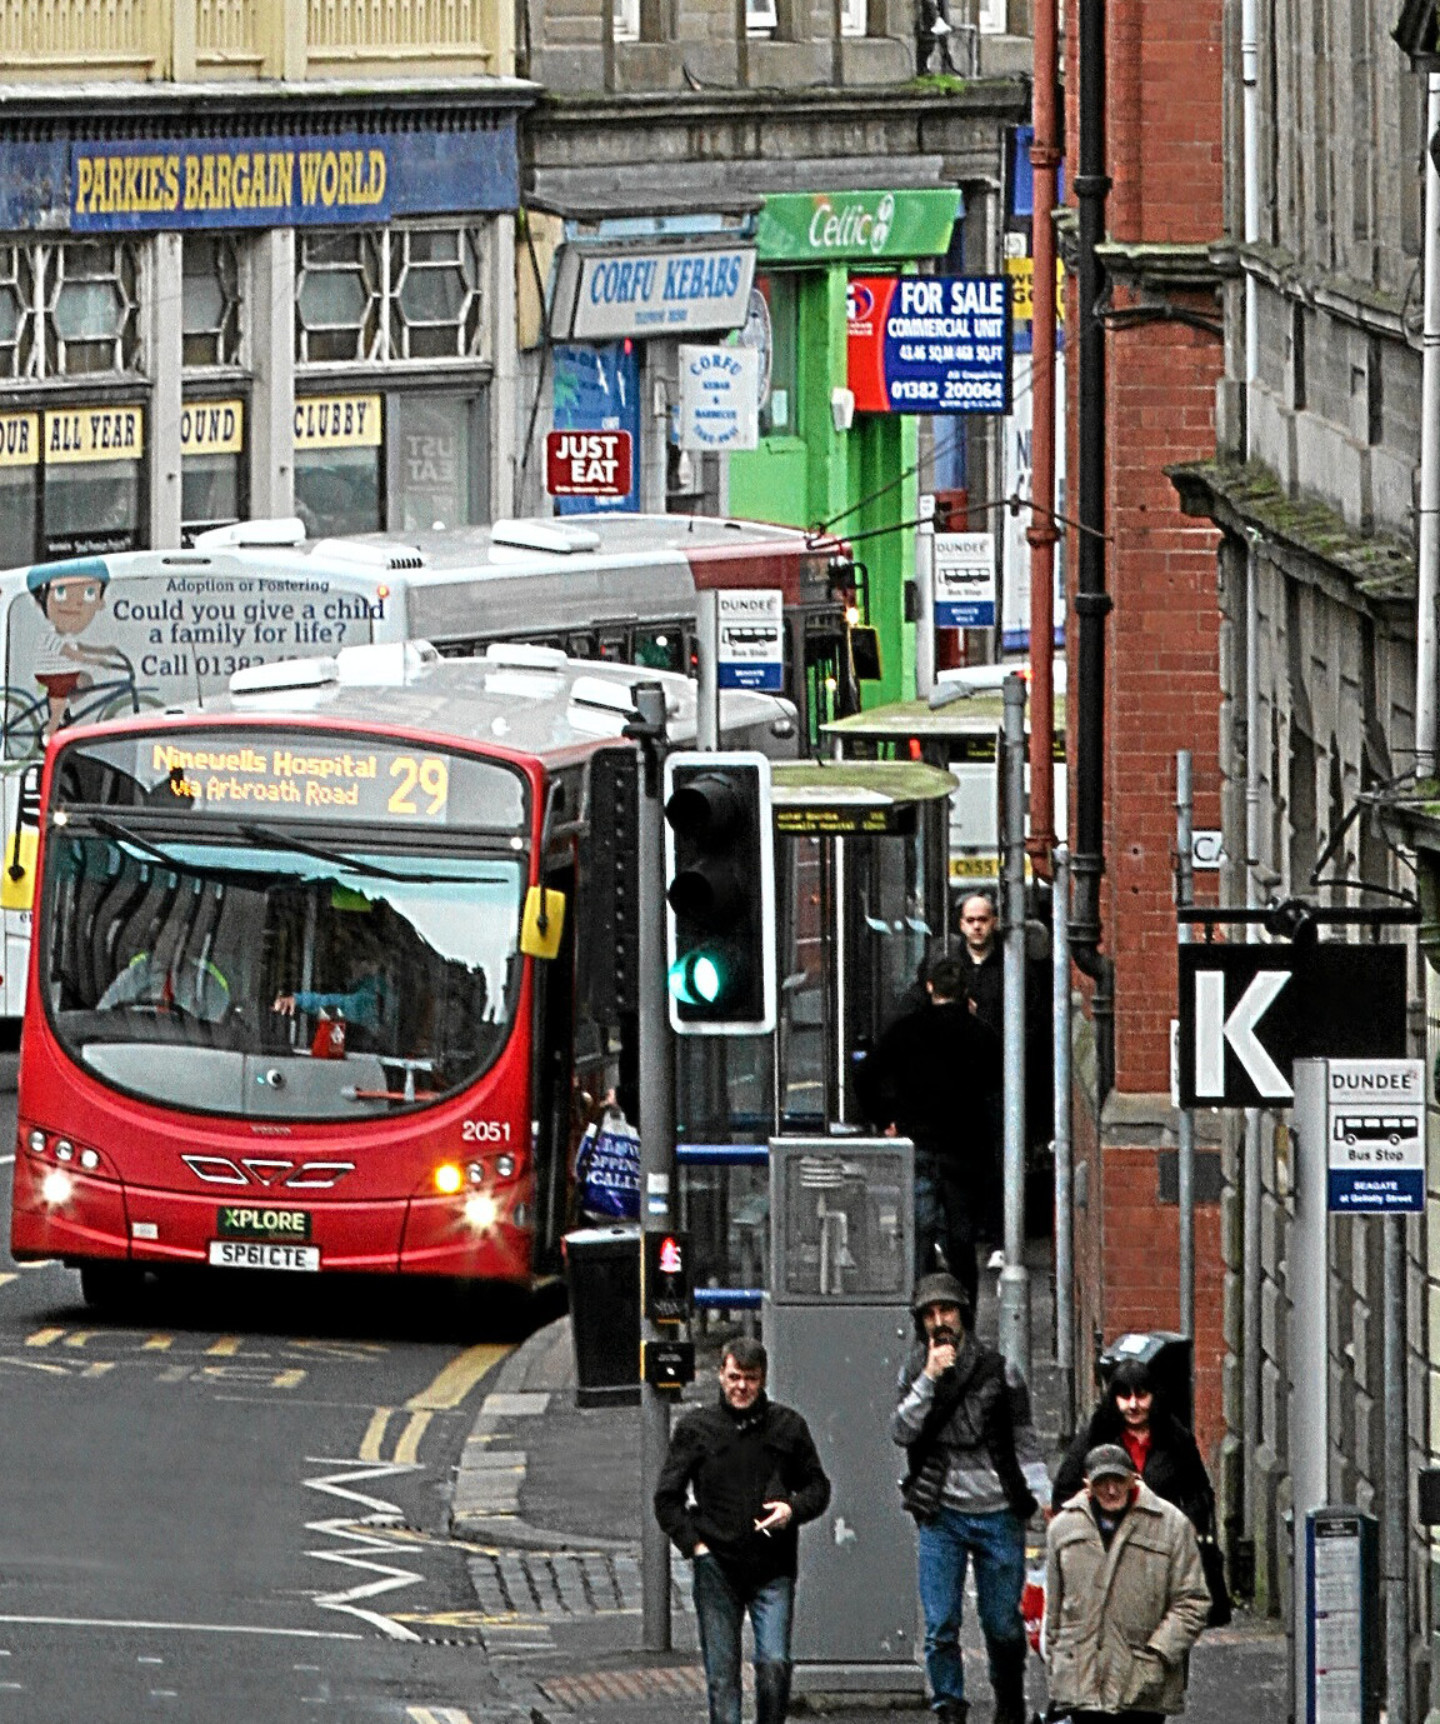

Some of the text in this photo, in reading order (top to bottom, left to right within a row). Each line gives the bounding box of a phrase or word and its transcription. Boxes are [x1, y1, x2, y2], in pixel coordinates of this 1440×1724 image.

[75, 149, 387, 213] PARKIES BARGAIN WORLD
[809, 203, 872, 248] Celtic
[591, 255, 741, 305] CORFU KEBABS
[901, 282, 1003, 315] FOR SALE
[888, 319, 970, 338] COMMERCIAL
[974, 319, 1003, 338] UNIT
[690, 354, 742, 376] CORFU
[891, 381, 1002, 399] 01382 200064
[50, 413, 136, 452] ALL YEAR
[181, 407, 236, 444] OUND
[555, 435, 619, 459] JUST
[571, 460, 619, 483] EAT
[937, 542, 987, 553] DUNDEE
[166, 578, 330, 595] Adoption or Fostering
[113, 598, 386, 630] Could you give a child
[721, 599, 775, 611] DUNDEE
[149, 622, 348, 649] a family for life?
[141, 654, 189, 677] Call
[152, 745, 449, 816] Ninewells Hospital 29
[170, 775, 360, 807] via Arbroath Road
[1195, 971, 1294, 1097] K
[1332, 1074, 1412, 1090] DUNDEE
[462, 1120, 512, 1141] 2051
[1348, 1149, 1404, 1162] Bus Stop
[1353, 1181, 1399, 1191] SEAGATE
[224, 1208, 306, 1232] XPLORE
[269, 1244, 307, 1268] CTE
